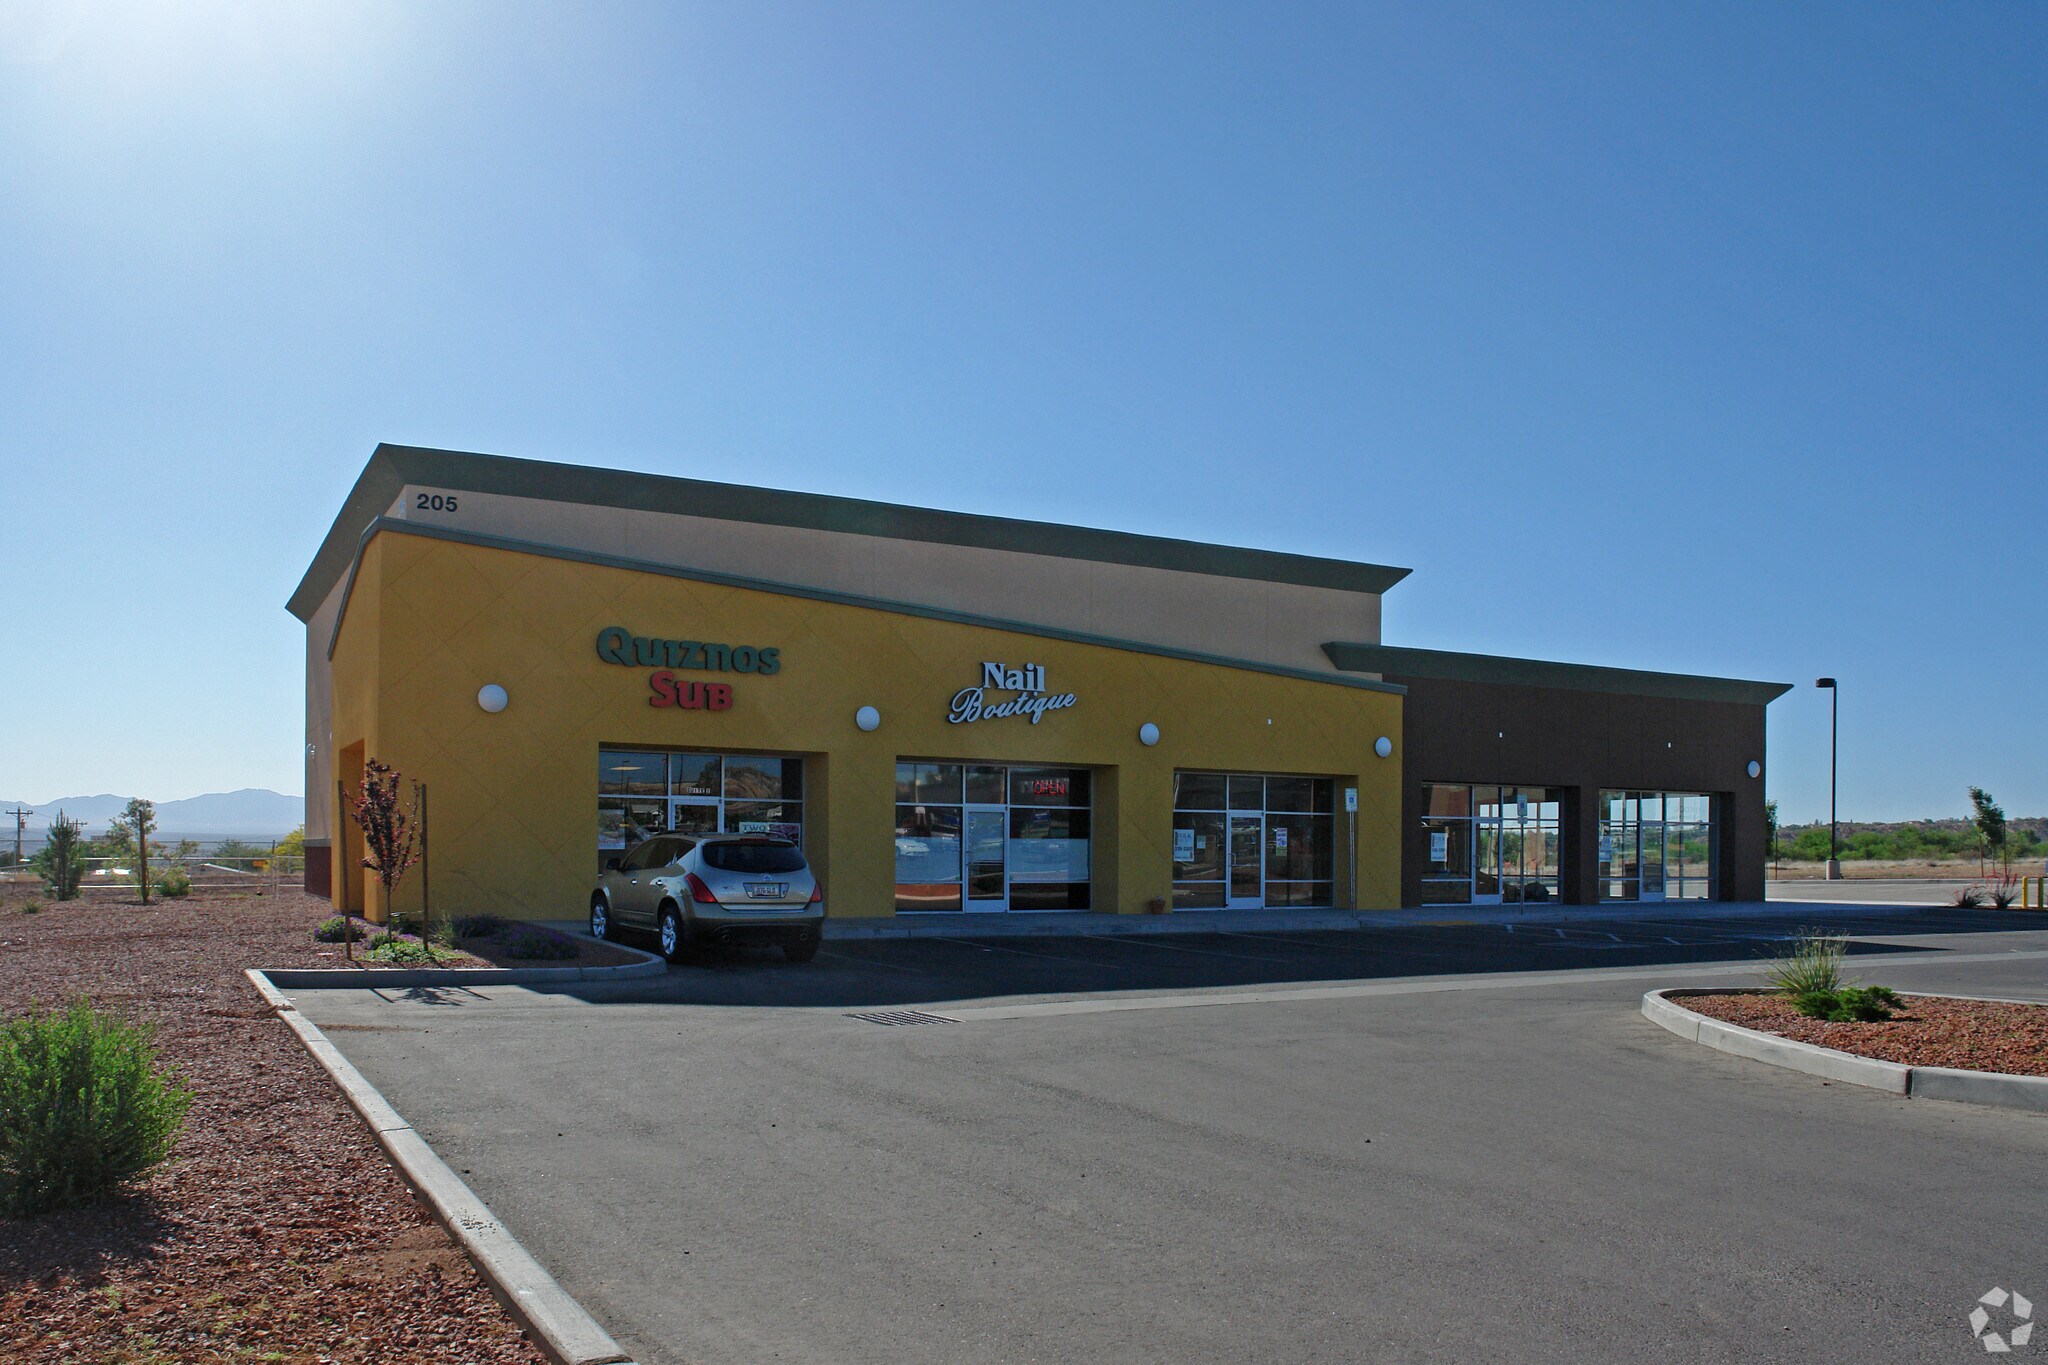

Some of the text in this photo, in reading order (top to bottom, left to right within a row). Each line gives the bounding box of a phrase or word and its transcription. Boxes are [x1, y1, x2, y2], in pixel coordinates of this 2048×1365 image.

[416, 493, 458, 513] 205
[596, 626, 781, 675] Quiznos
[981, 661, 1046, 693] Nail
[947, 687, 1077, 725] Boutique
[1033, 781, 1066, 795] OPEN
